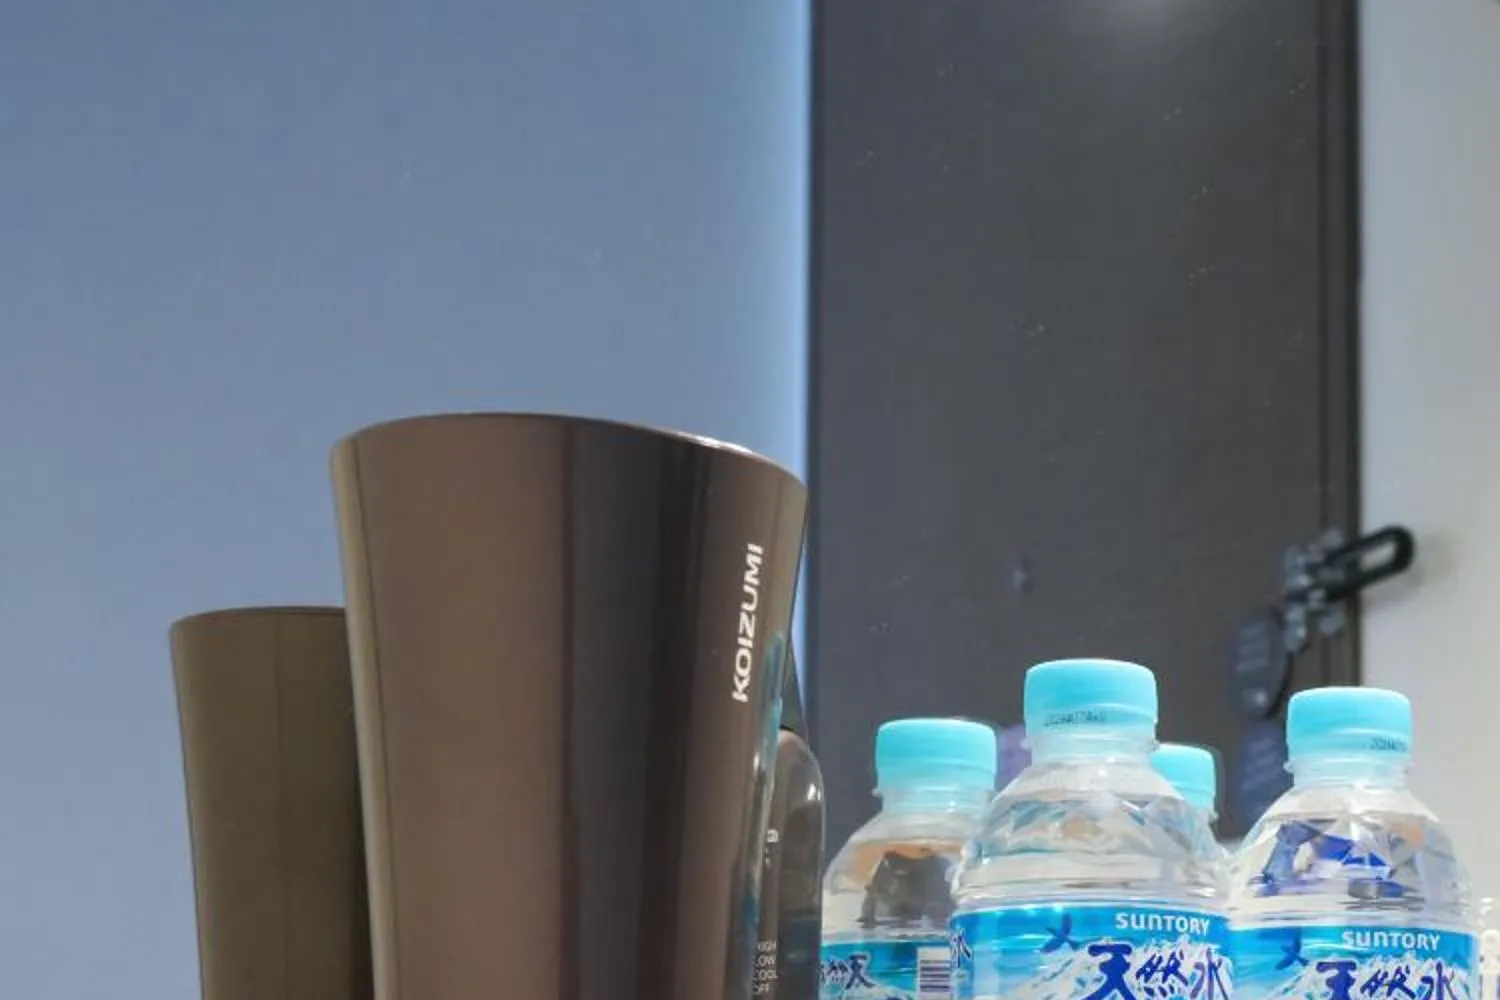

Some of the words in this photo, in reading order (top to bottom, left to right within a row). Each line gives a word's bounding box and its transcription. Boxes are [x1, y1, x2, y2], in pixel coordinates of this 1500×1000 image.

[731, 543, 764, 703] KOIZUMI
[1115, 912, 1210, 935] SUNTORY
[1342, 931, 1441, 950] SUNTORY
